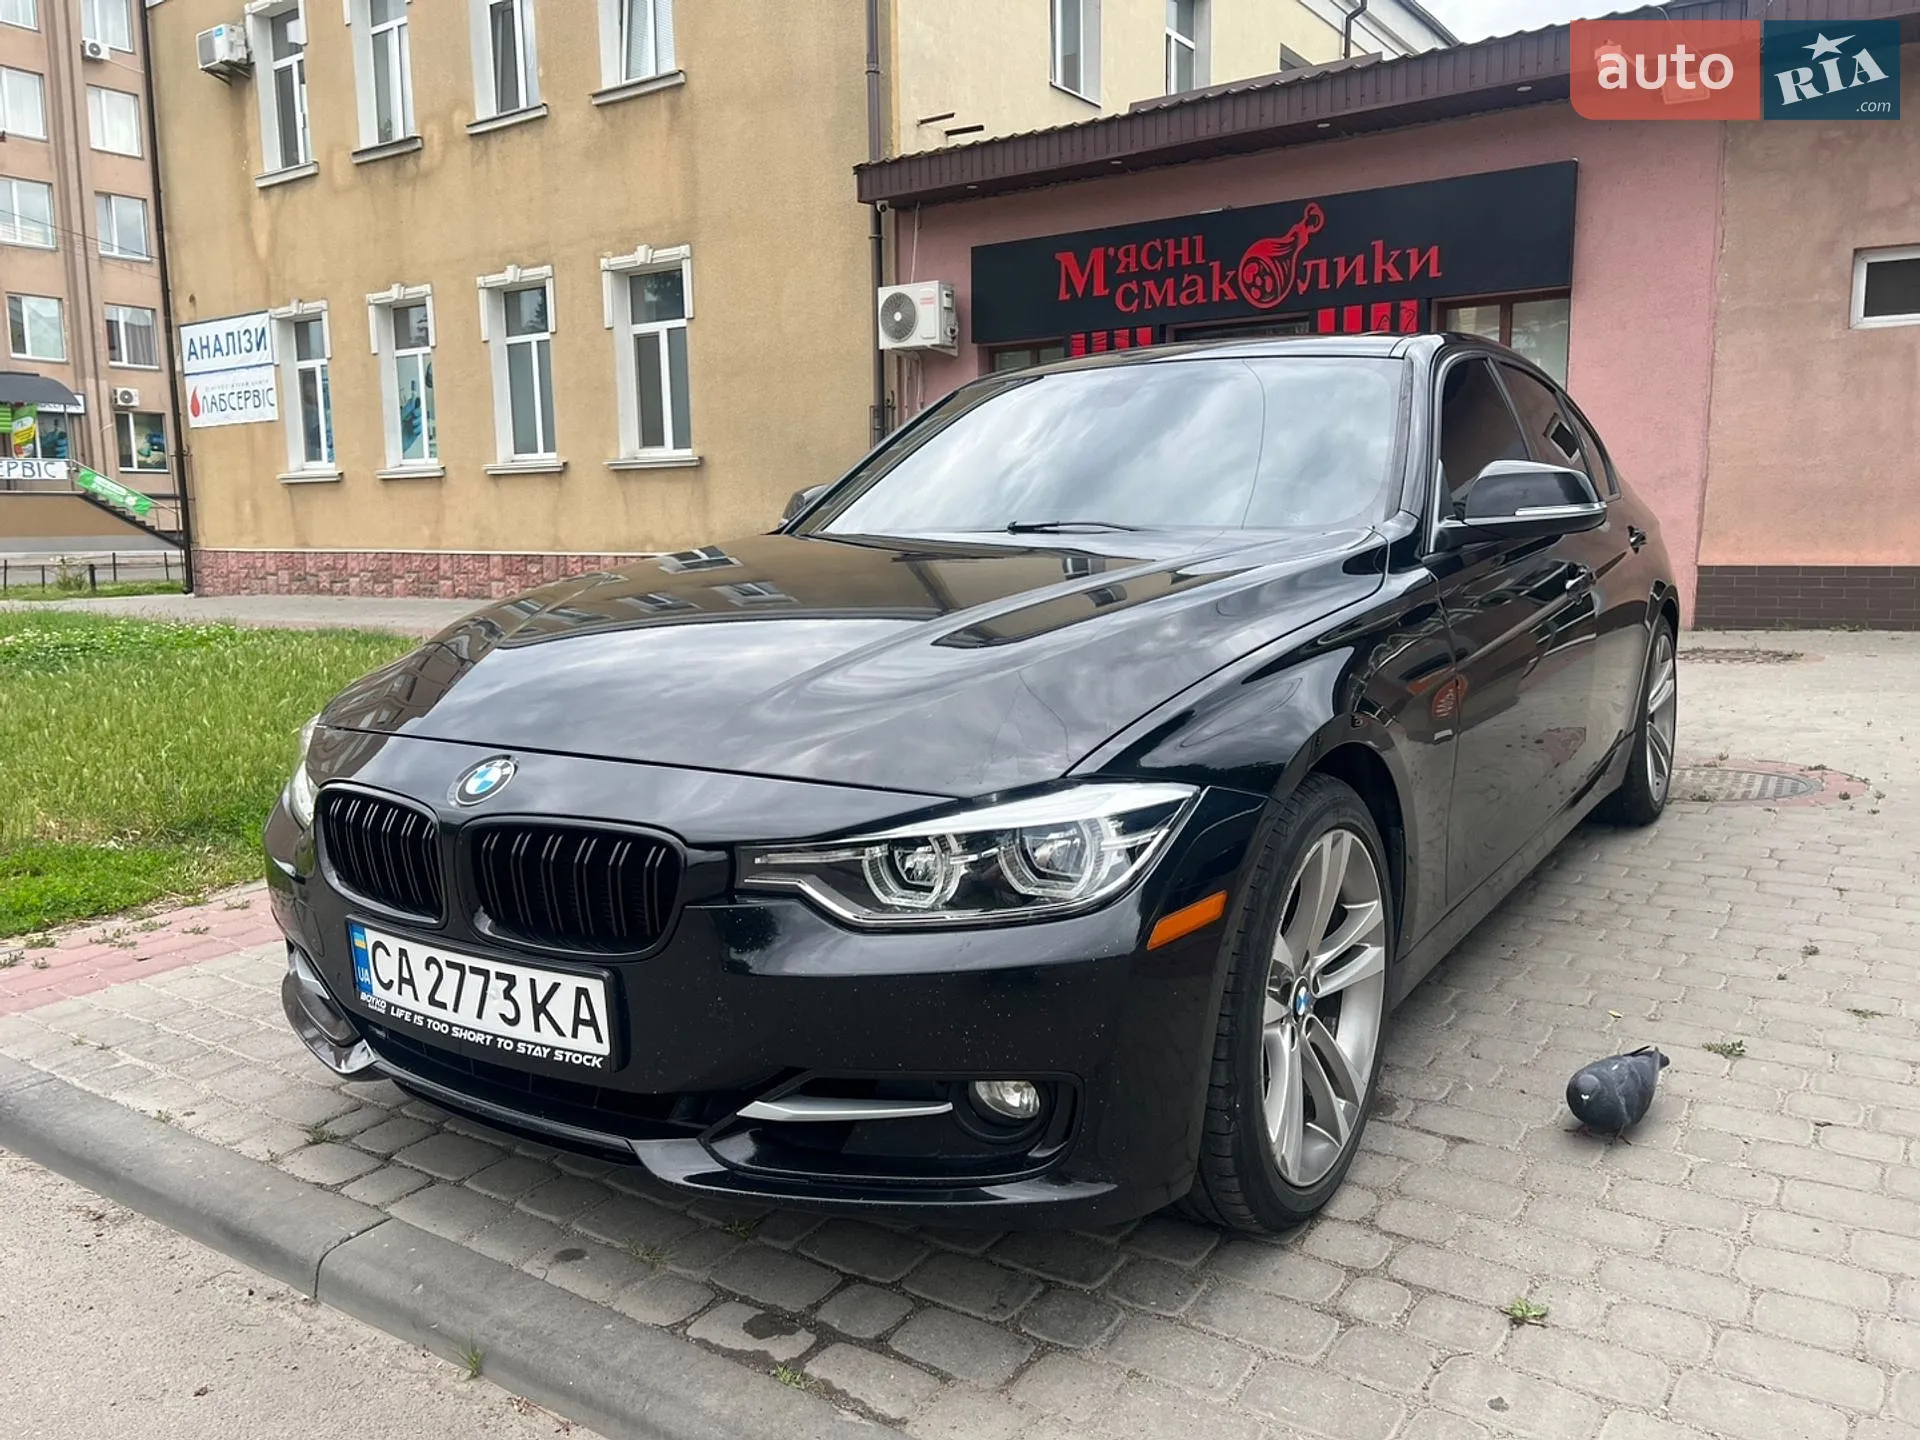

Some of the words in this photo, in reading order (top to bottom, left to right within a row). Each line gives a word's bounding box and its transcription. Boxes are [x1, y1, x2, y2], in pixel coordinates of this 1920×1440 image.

[187, 326, 267, 362] АНАЛІЗИ
[202, 387, 275, 415] ЛАБСЕРВІС
[357, 964, 371, 985] UA
[390, 1005, 412, 1022] LIFE
[413, 1014, 424, 1026] IS
[427, 1018, 450, 1034] TOO
[451, 1026, 493, 1046] SHORT
[496, 1036, 514, 1051] TO
[516, 1042, 551, 1058] STAY
[553, 1050, 604, 1068] STOCK
